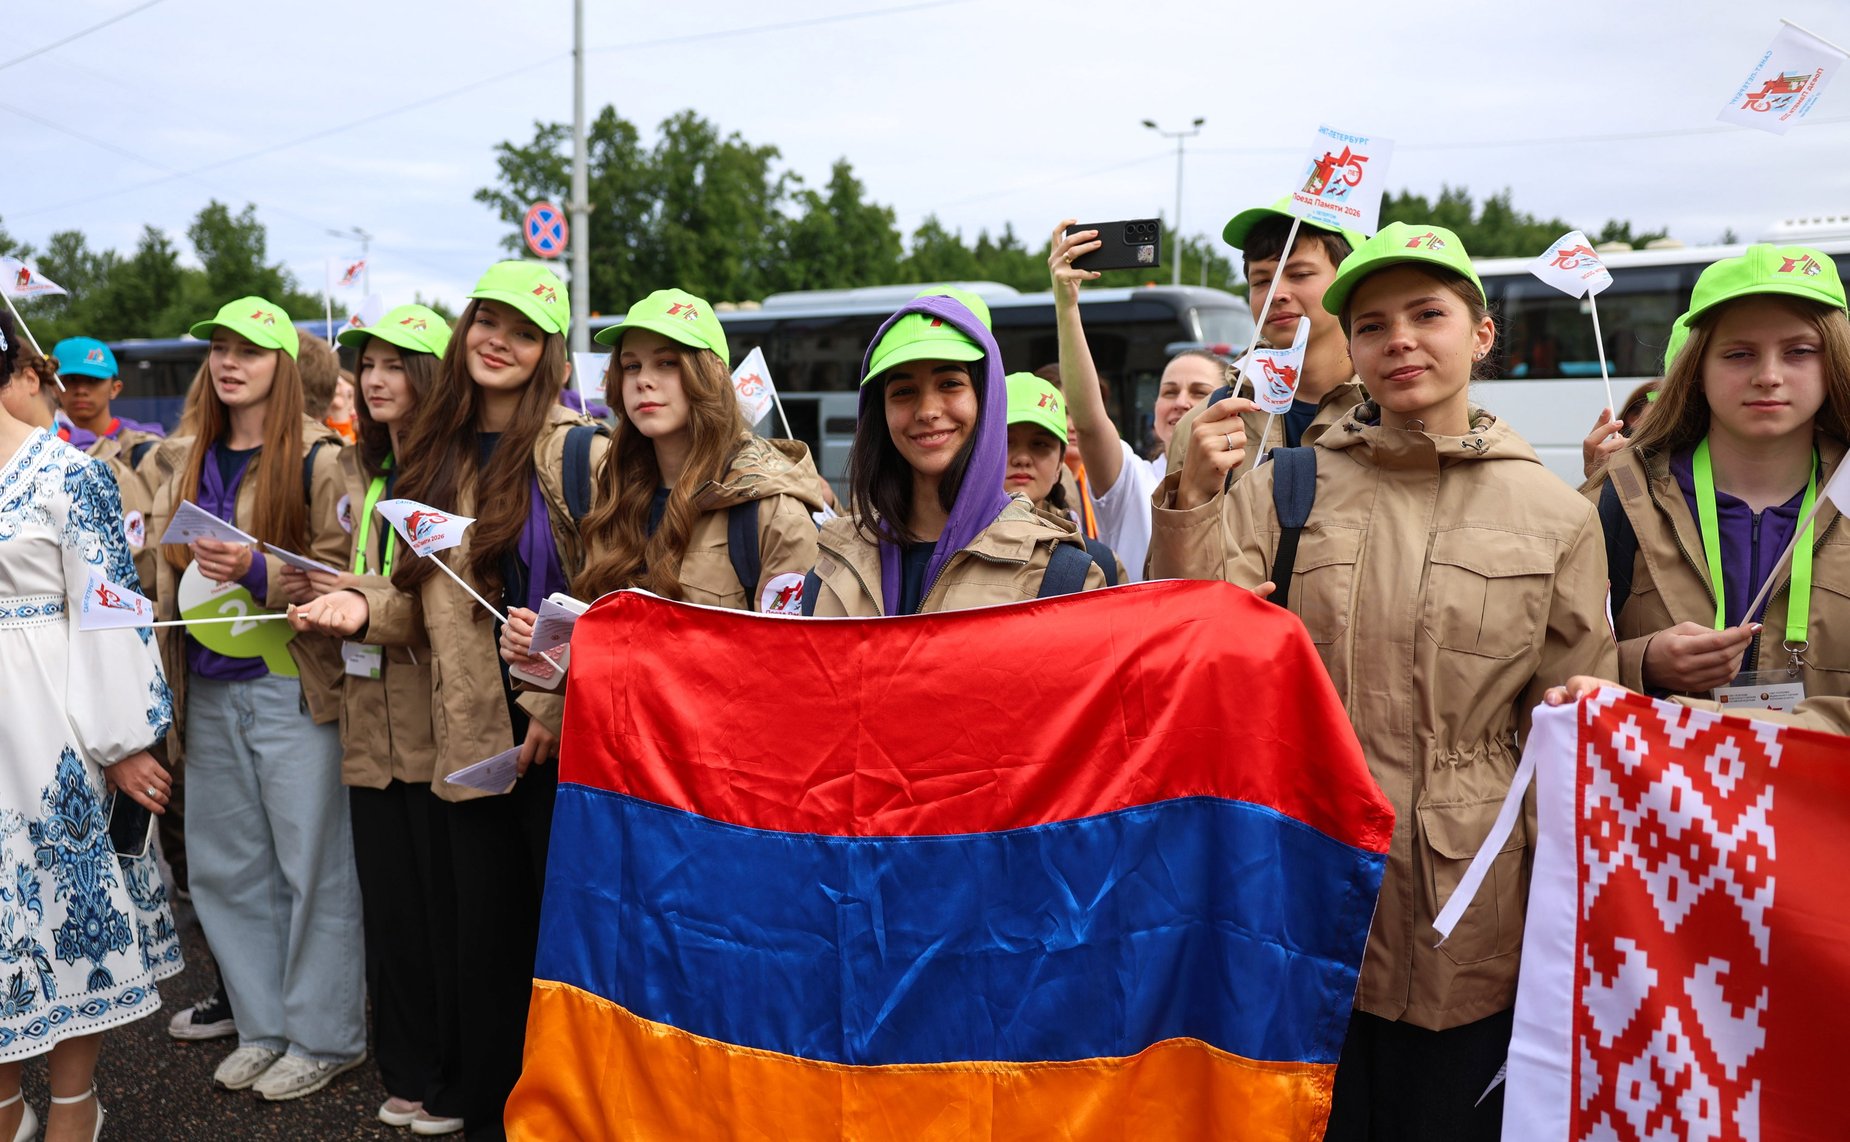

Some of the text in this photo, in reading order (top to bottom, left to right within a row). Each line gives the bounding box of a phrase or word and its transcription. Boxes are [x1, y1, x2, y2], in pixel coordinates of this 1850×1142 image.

[1315, 198, 1344, 213] Памяти
[1344, 206, 1361, 218] 2026
[431, 533, 445, 542] 2026
